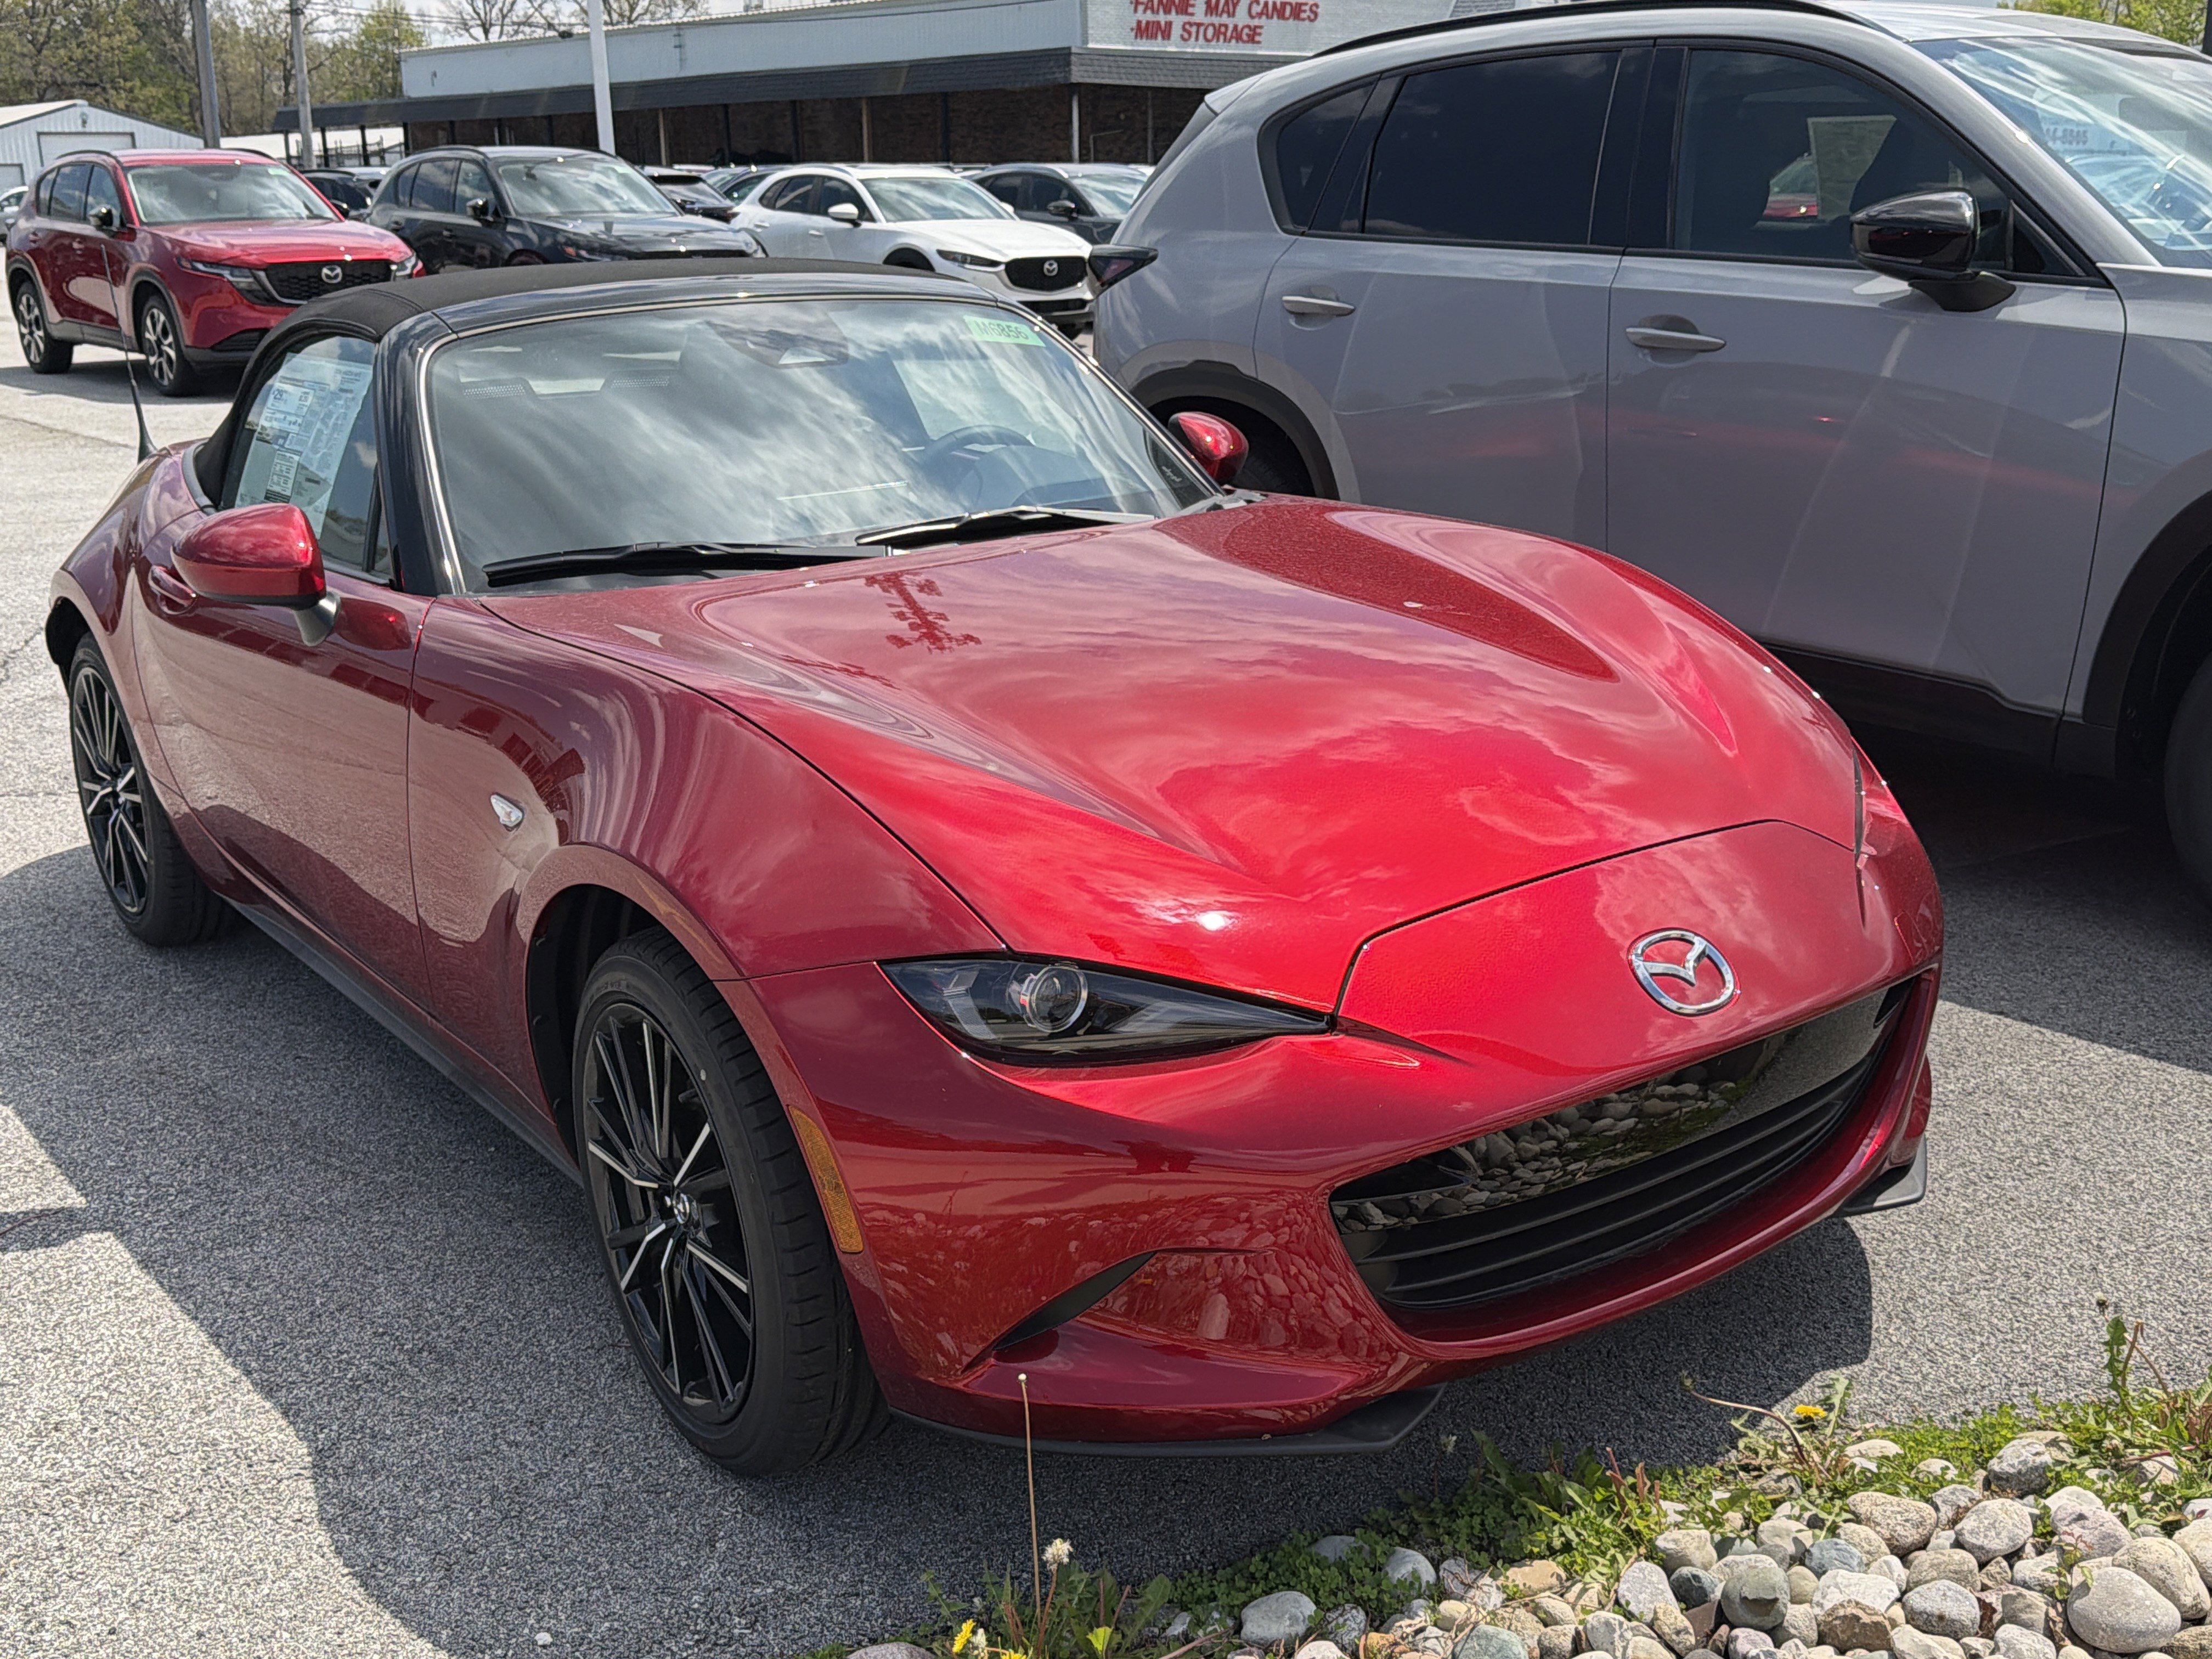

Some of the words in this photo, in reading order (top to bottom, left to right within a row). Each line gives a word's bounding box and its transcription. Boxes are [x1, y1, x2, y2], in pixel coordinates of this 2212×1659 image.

[1133, 0, 1195, 16] FANNIE
[1204, 0, 1239, 18] MAY
[1248, 0, 1320, 22] CANDIES
[1134, 20, 1173, 41] MINI
[1180, 21, 1263, 44] STORAGE
[974, 320, 1029, 340] M6856
